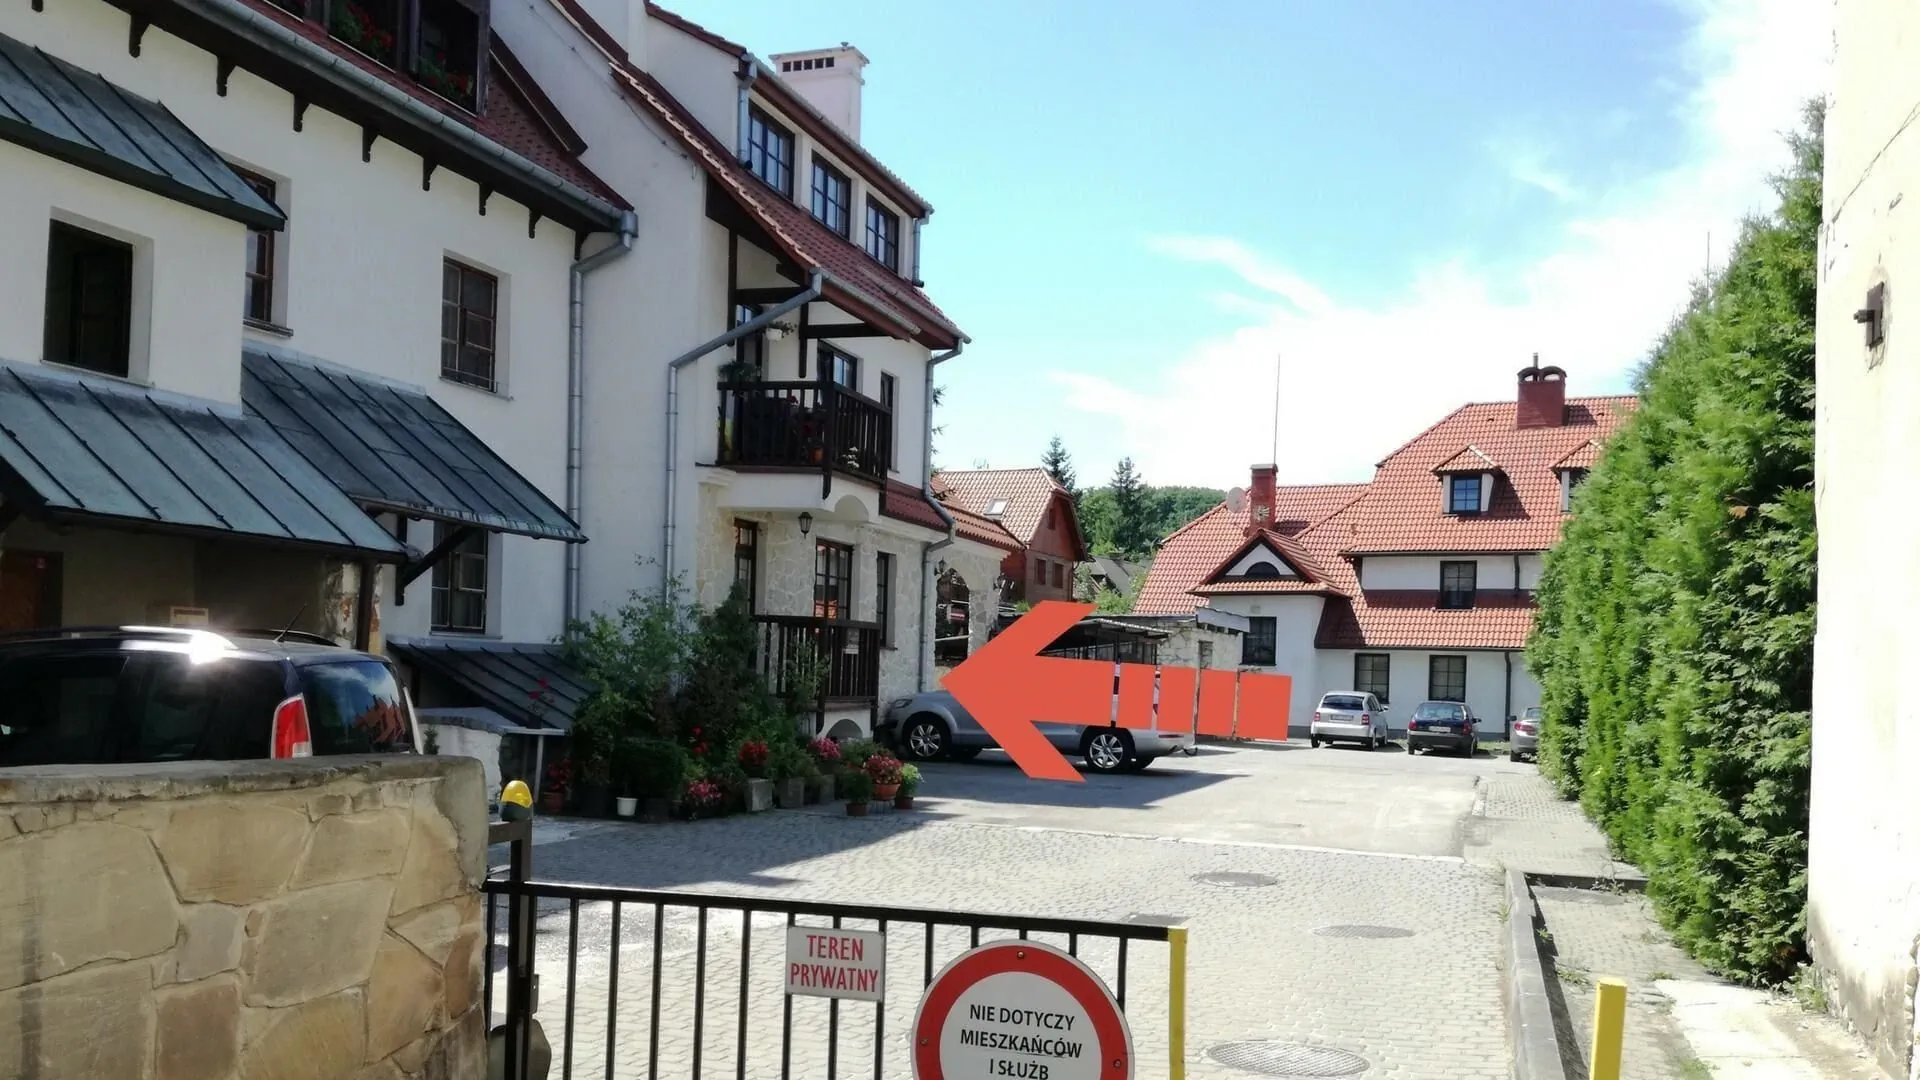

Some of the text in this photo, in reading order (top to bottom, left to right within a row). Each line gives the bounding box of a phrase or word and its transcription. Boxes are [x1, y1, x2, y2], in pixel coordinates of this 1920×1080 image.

[806, 934, 864, 961] TEREN
[790, 962, 878, 992] PRYWATNY
[969, 1004, 1075, 1031] NIE DOTYCZY
[960, 1029, 1082, 1058] MIESZKAŃCÓW
[989, 1058, 1049, 1080] I SŁUŻB
